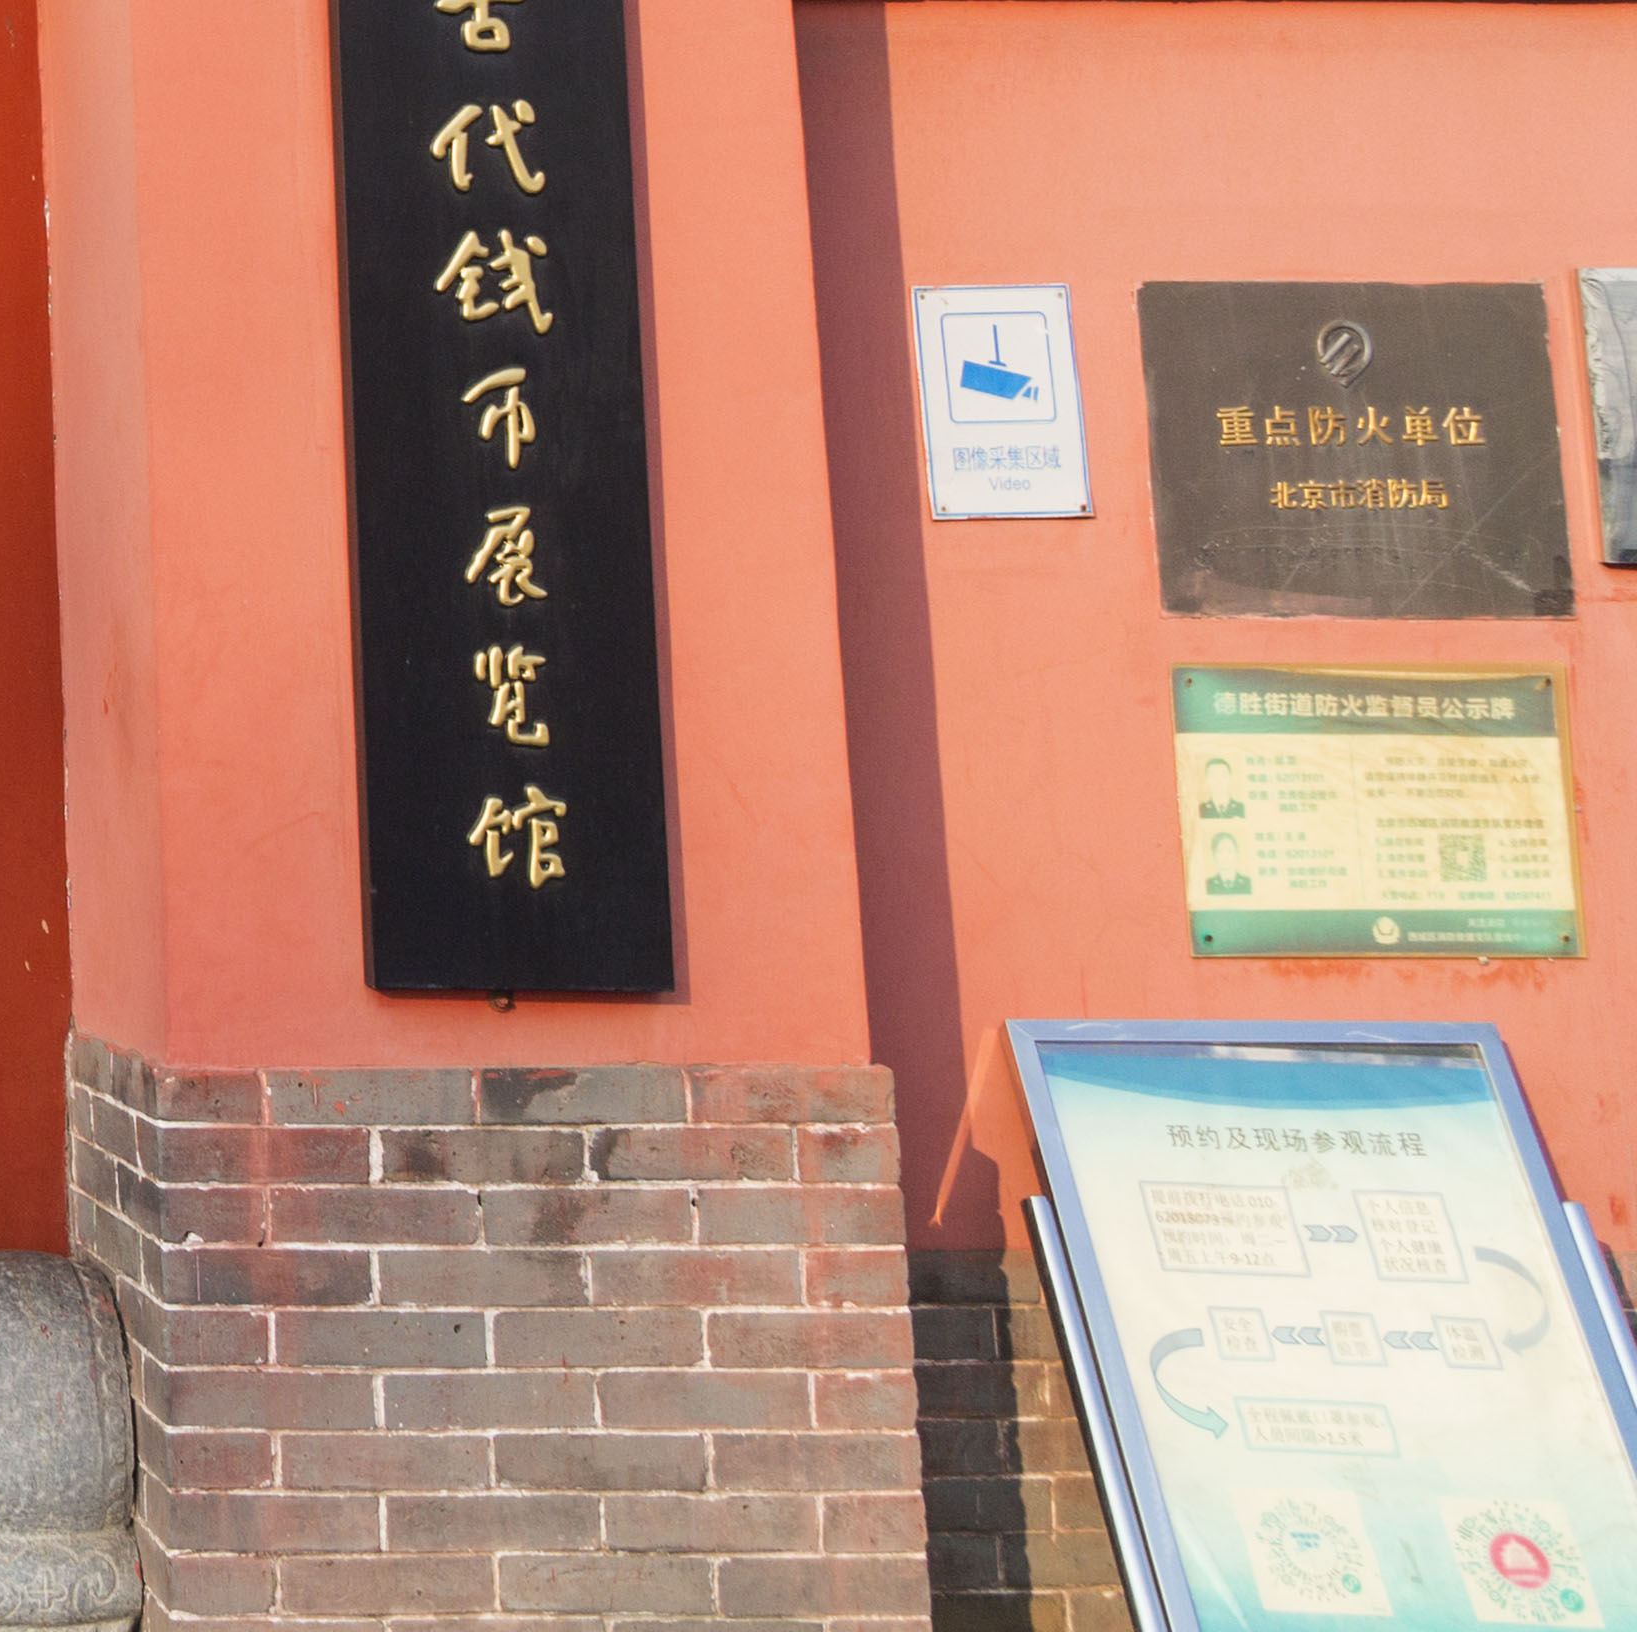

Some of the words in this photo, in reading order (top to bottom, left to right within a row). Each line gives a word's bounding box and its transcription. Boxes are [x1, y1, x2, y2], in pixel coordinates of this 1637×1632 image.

[1215, 405, 1487, 447] 重点防火单位
[952, 444, 1062, 472] 图像采集区域
[988, 477, 1032, 491] Video
[1269, 478, 1450, 510] 北京市消防局
[1165, 1123, 1430, 1158] 预约及现场参观流程
